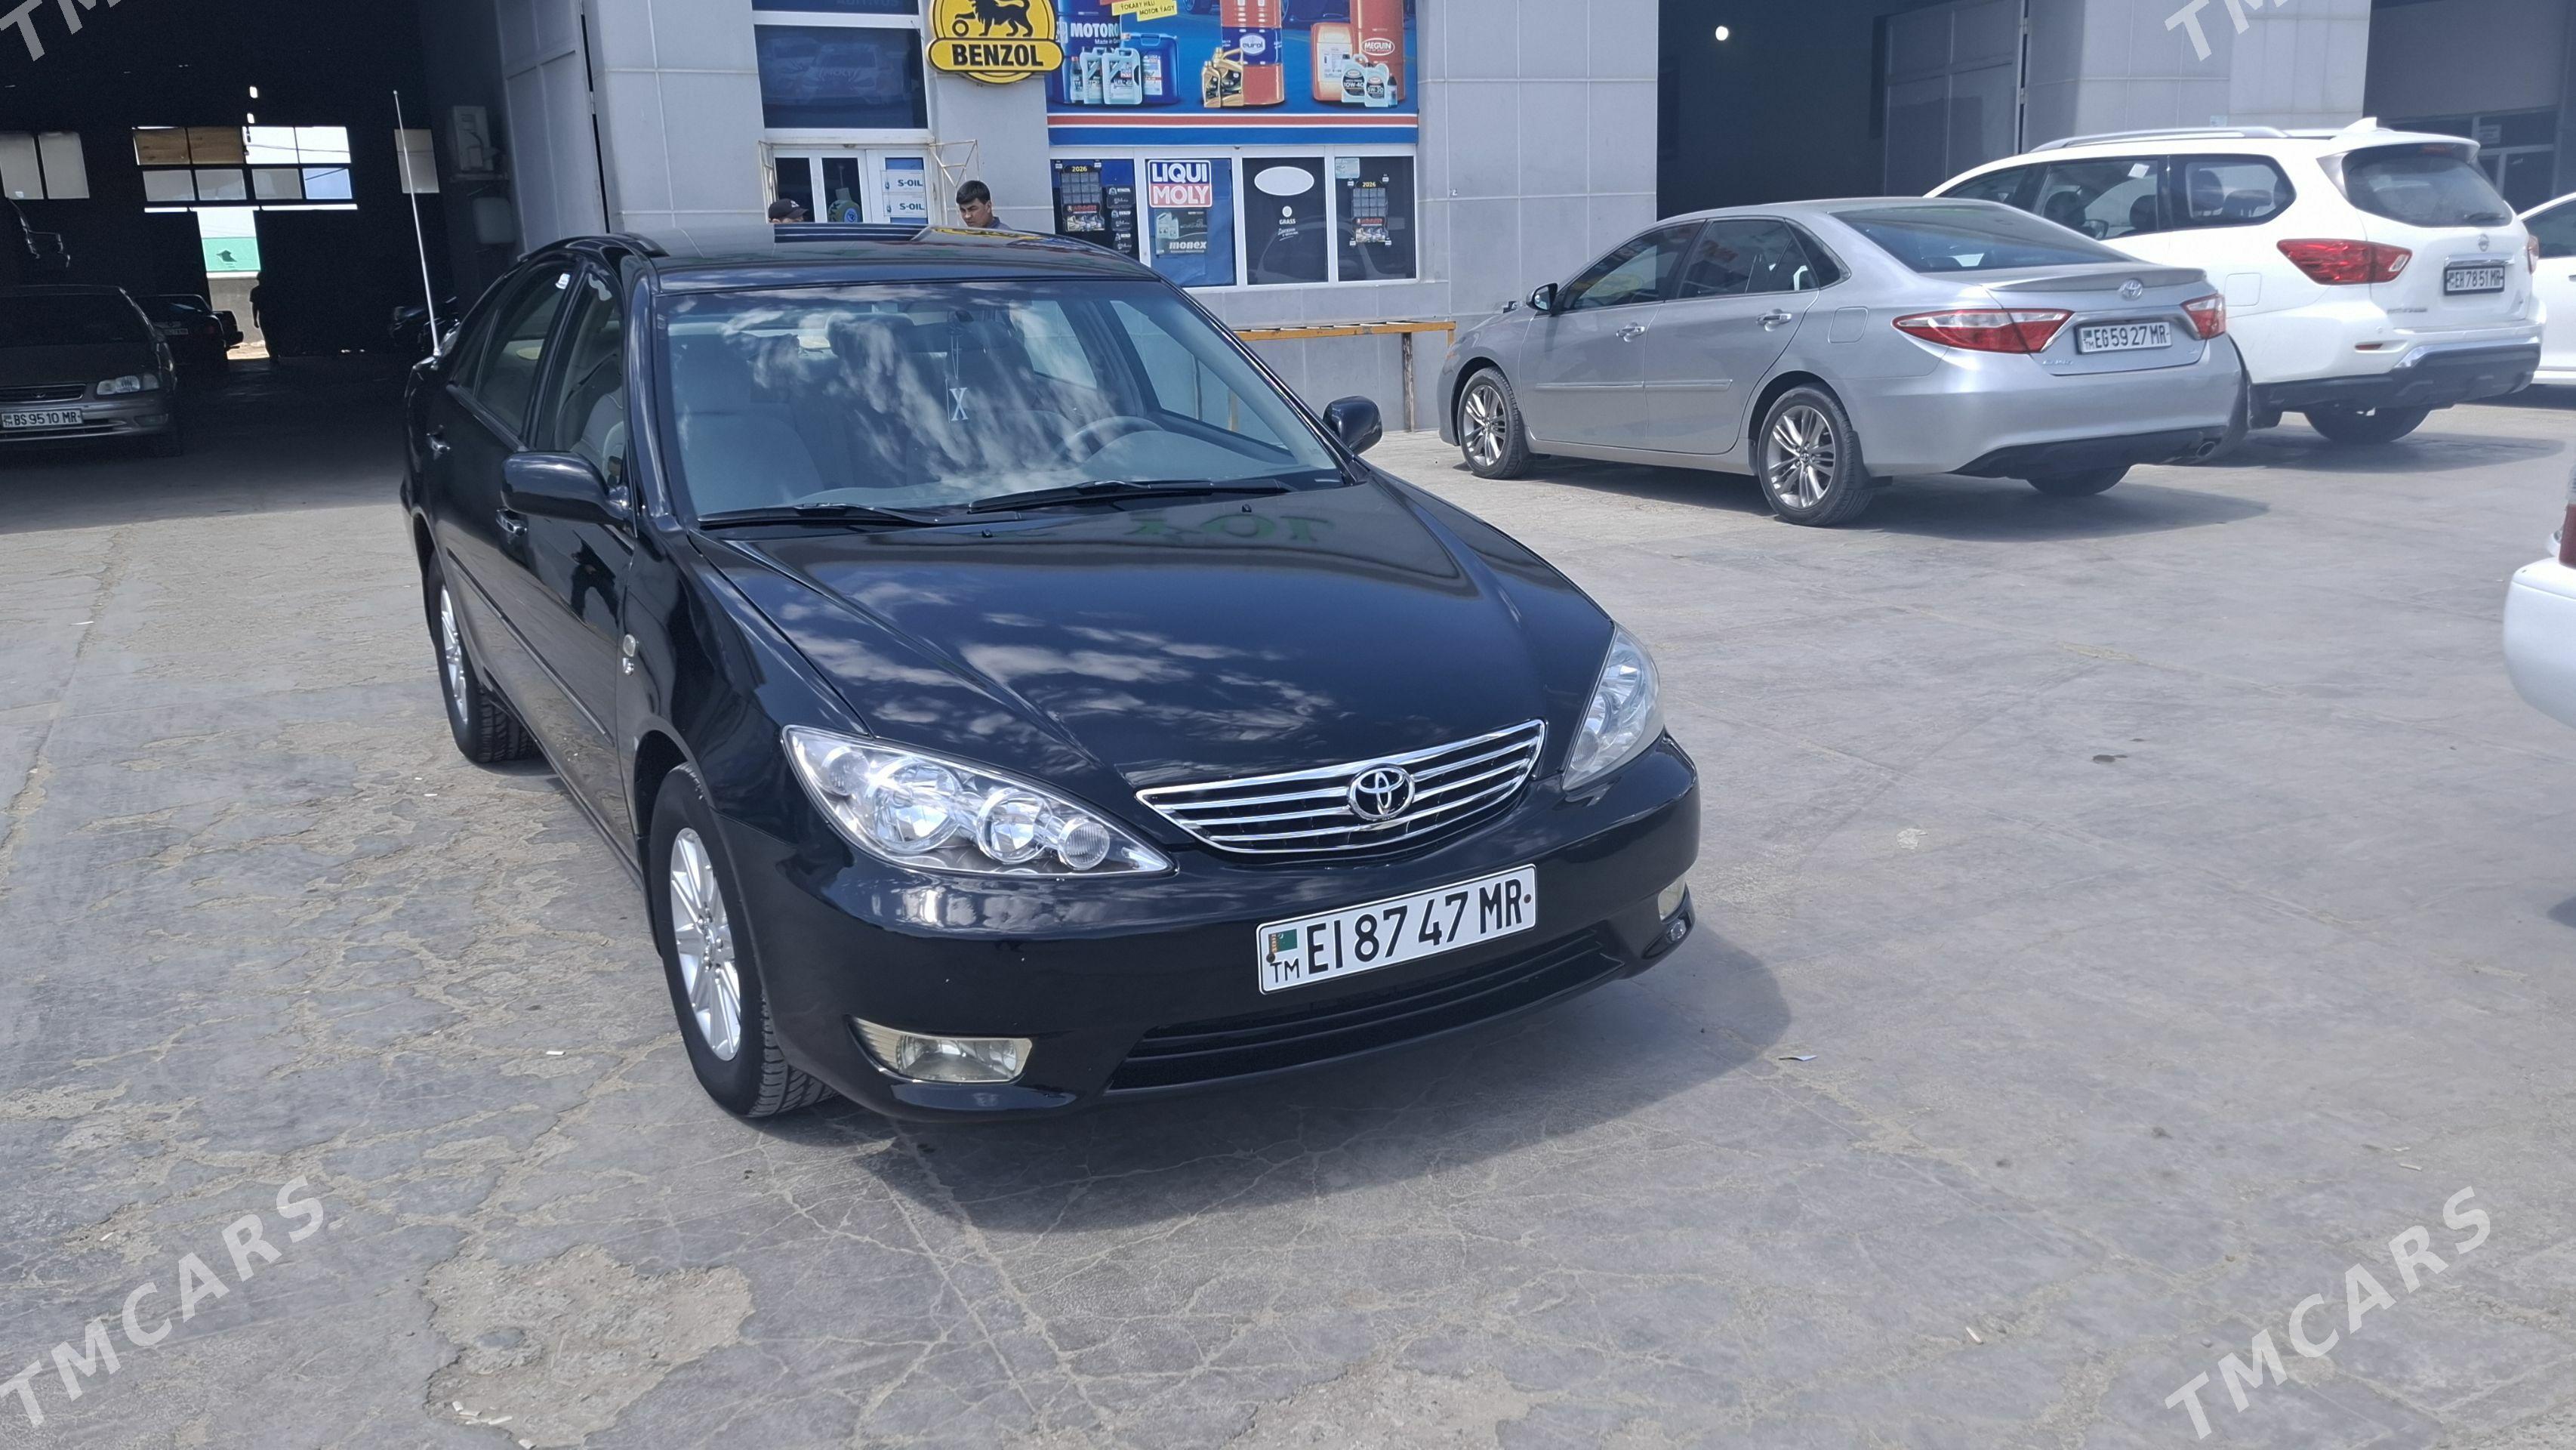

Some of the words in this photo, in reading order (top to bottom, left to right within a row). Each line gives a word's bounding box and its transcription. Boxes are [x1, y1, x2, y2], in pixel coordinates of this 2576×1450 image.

[951, 44, 1043, 66] BENZOL
[1364, 42, 1391, 50] MEGUIN
[898, 178, 923, 187] S-OIL
[1152, 163, 1207, 184] LIQUI
[1153, 185, 1209, 205] MOLY
[899, 202, 926, 211] S-OIL
[2467, 270, 2477, 287] 78
[2479, 270, 2488, 286] 51
[2094, 329, 2109, 348] EG
[2110, 327, 2128, 347] 59
[2130, 325, 2147, 345] 27
[2149, 324, 2167, 344] MR
[14, 414, 27, 425] BS
[29, 413, 45, 424] 95
[46, 412, 60, 424] 10
[62, 412, 77, 423] MR
[1306, 920, 1344, 974] EI
[1354, 905, 1407, 962] 87
[1418, 890, 1468, 946] 47
[1479, 878, 1523, 933] MR
[1270, 957, 1300, 983] TM
